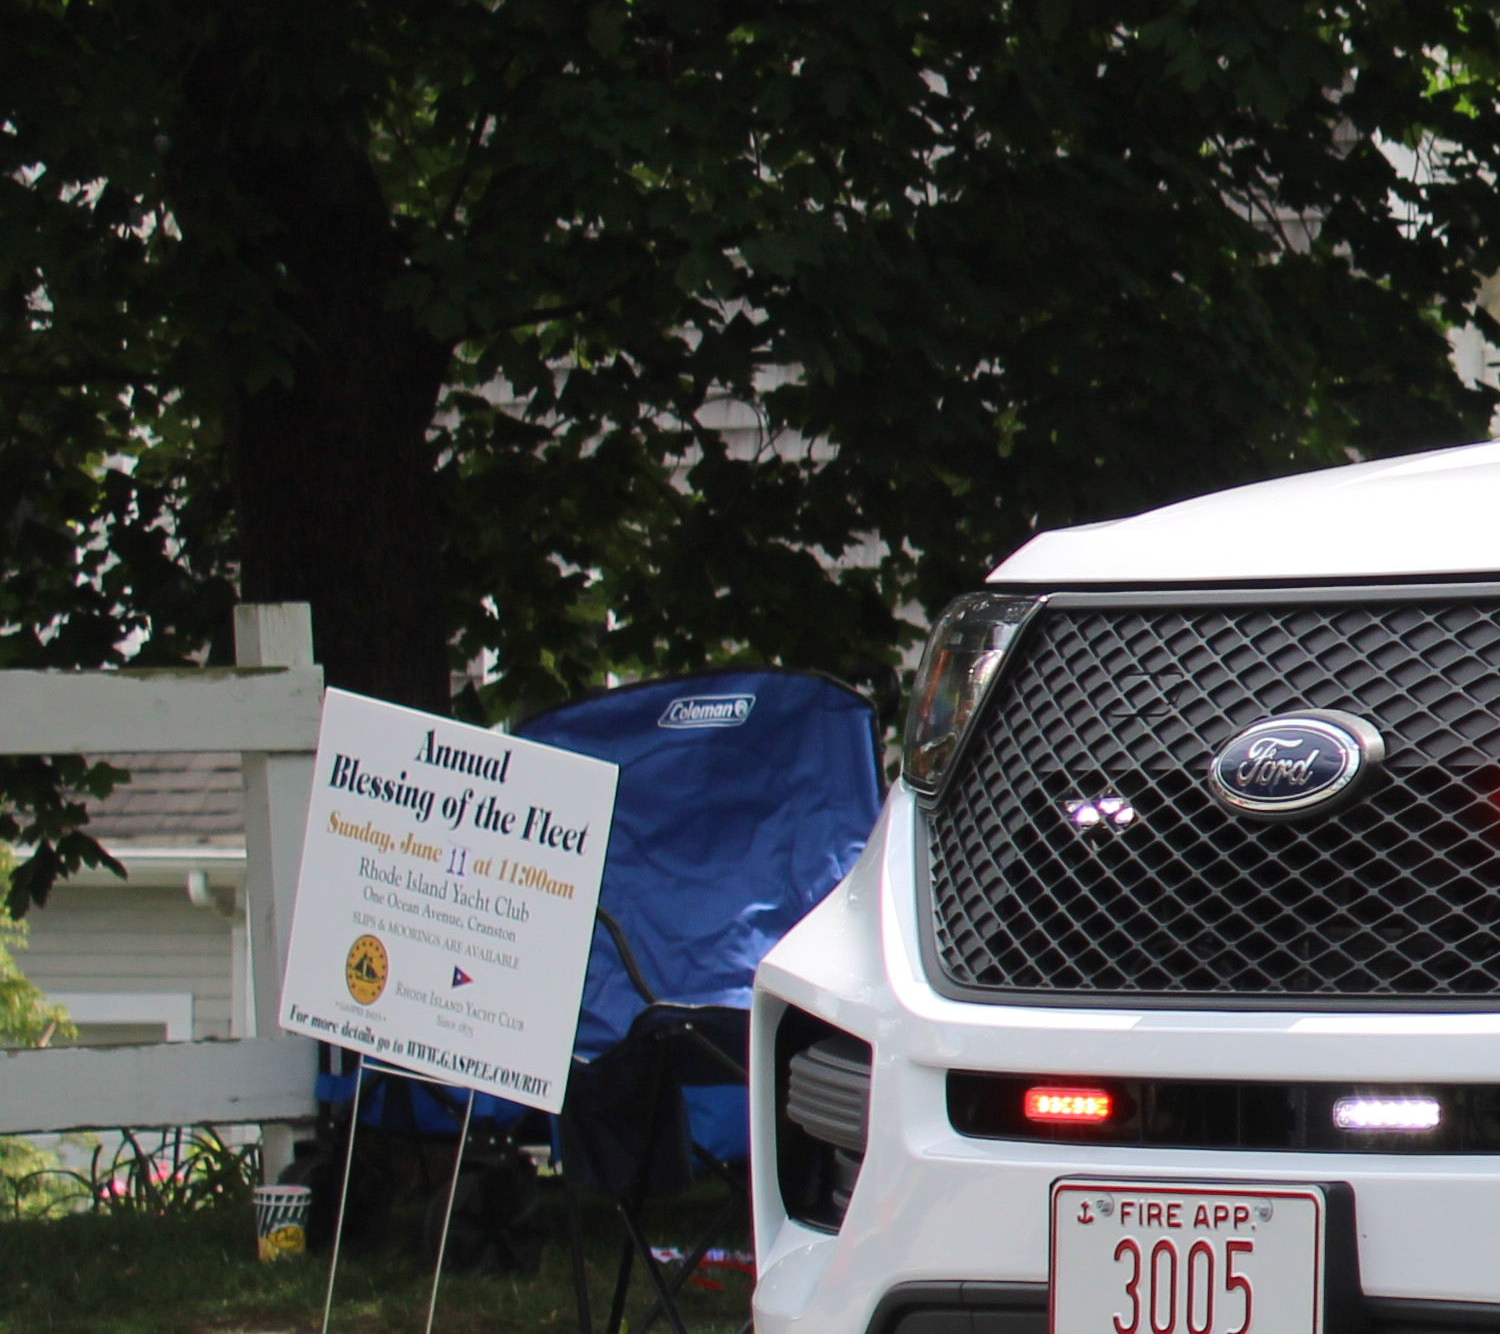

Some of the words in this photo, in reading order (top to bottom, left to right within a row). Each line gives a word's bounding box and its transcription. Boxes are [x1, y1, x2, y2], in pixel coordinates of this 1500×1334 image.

[670, 700, 734, 722] Coleman
[414, 728, 512, 784] Annual
[1237, 737, 1320, 787] Ford
[328, 753, 436, 823] Blessing
[442, 788, 473, 831] of
[474, 796, 516, 834] the
[520, 805, 591, 856] Fleet
[358, 857, 403, 887] Rhode
[407, 870, 448, 901] Island
[453, 883, 490, 913] Yacht
[495, 896, 530, 923] Club
[400, 832, 444, 863] June
[446, 847, 467, 878] 11
[473, 857, 493, 878] at
[498, 858, 575, 900] 11:00am
[353, 911, 376, 928] SLIPS
[377, 919, 386, 932] &
[387, 921, 442, 946] MOORINGS
[442, 938, 463, 954] ARE
[464, 943, 521, 970] AVAILABLE
[363, 885, 385, 905] One
[387, 893, 420, 915] Ocean
[422, 902, 465, 928] Avenue,
[467, 915, 517, 943] Cranston
[290, 1004, 309, 1025] For
[311, 1015, 339, 1034] more
[341, 1020, 375, 1044] details
[376, 1036, 391, 1052] go
[392, 1038, 404, 1054] to
[395, 981, 427, 1004] RHODE
[429, 991, 463, 1014] ISLAND
[466, 1001, 498, 1024] YACHT
[498, 1011, 525, 1031] CLUB
[1121, 1200, 1184, 1229] FIRE
[1194, 1204, 1256, 1231] APP.
